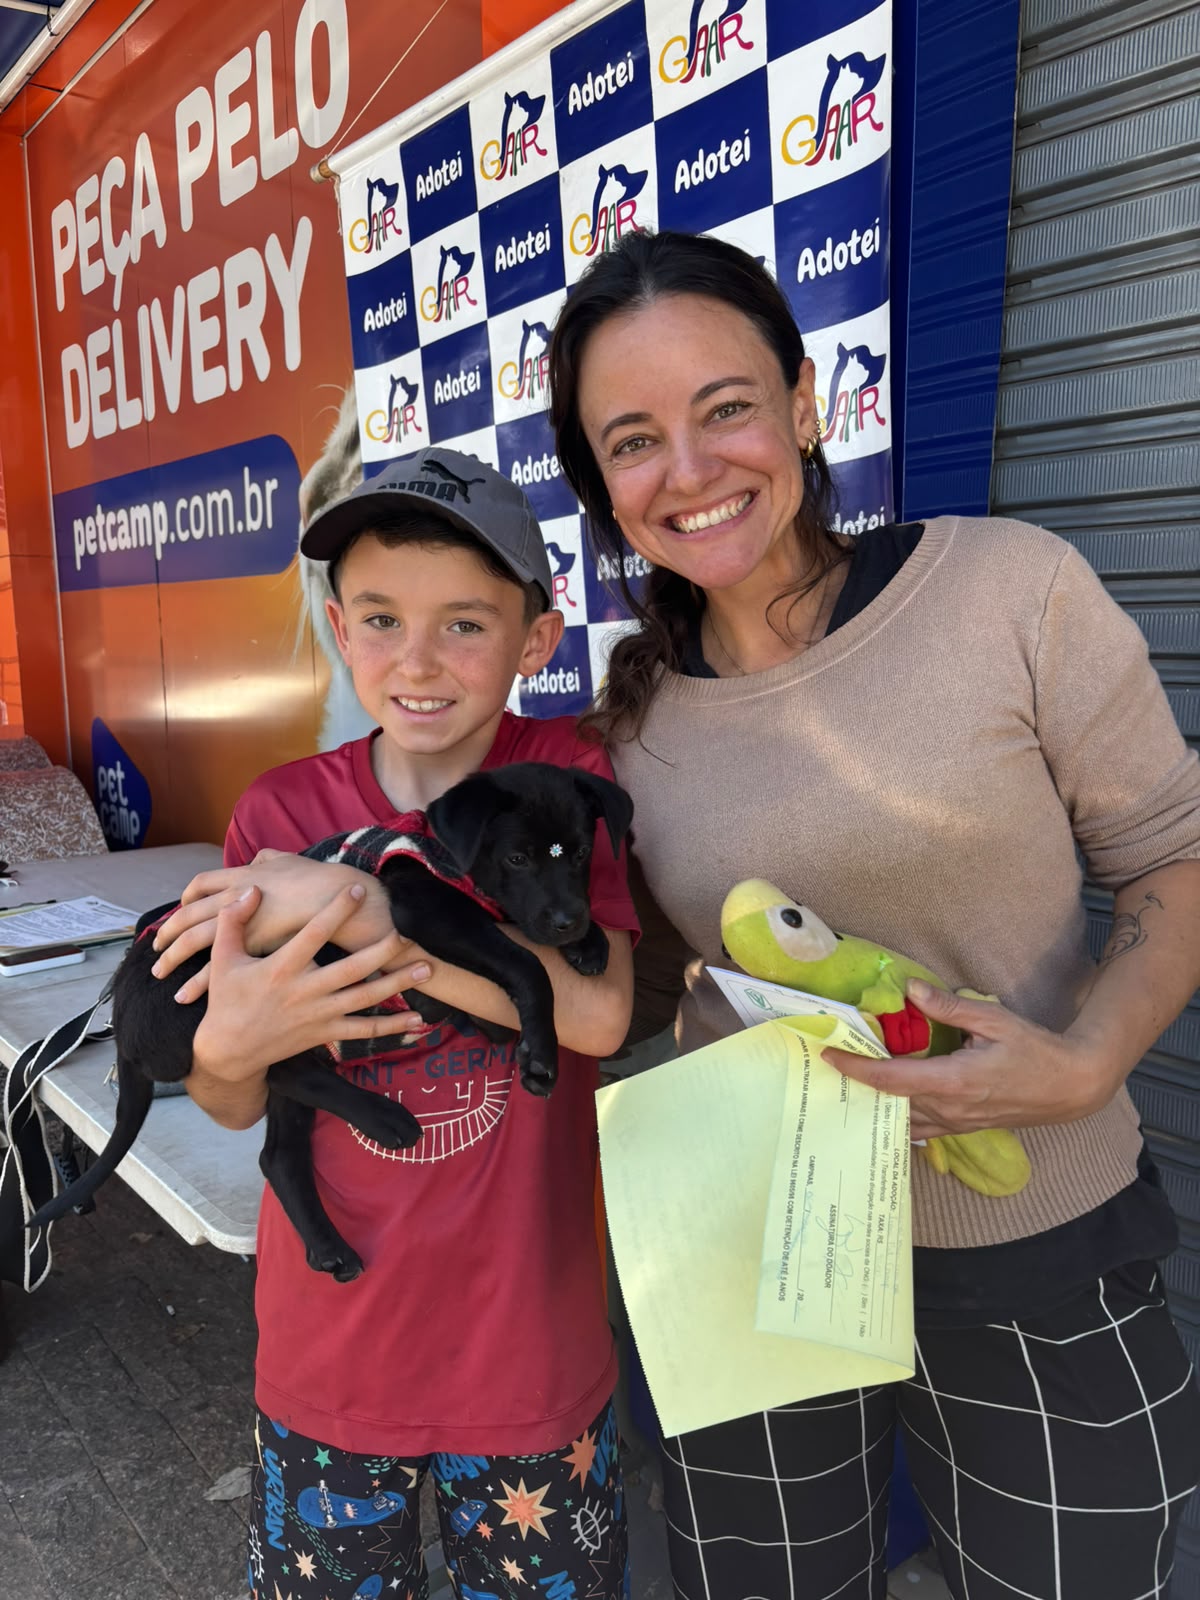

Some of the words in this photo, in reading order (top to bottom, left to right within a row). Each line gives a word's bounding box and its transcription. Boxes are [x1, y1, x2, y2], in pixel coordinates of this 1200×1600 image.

[658, 12, 754, 85] GAAR
[568, 51, 636, 116] Adotei
[780, 92, 884, 167] GAAR
[51, 132, 167, 312] PEÇA
[175, 0, 350, 233] PELO
[480, 124, 548, 181] GAAR
[674, 129, 751, 194] Adotei
[416, 150, 463, 202] Adotei
[349, 202, 402, 254] GAAR
[494, 223, 551, 274] Adotei
[796, 218, 881, 283] Adotei
[363, 291, 408, 333] Adotei
[420, 276, 477, 323] GAAR
[61, 216, 313, 449] DELIVERY
[433, 361, 482, 406] Adotei
[365, 405, 422, 443] GAAR
[511, 453, 560, 486] Adote
[73, 466, 278, 571] petcamp.com.br
[528, 666, 580, 694] Adotei
[801, 1059, 811, 1092] MALTRATAR
[799, 1092, 808, 1114] ANIMAIS
[791, 1160, 799, 1169] NA
[792, 1133, 803, 1160] DESCRITO
[892, 1171, 898, 1181] DA
[786, 1200, 795, 1215] COM
[828, 1204, 838, 1246] ASSINATURA
[782, 1215, 794, 1250] DETENÇÃO
[826, 1246, 834, 1258] DO
[780, 1260, 790, 1275] ATÉ
[781, 1251, 790, 1261] DE
[824, 1258, 833, 1289] DOADOR
[778, 1281, 787, 1302] ANOS
